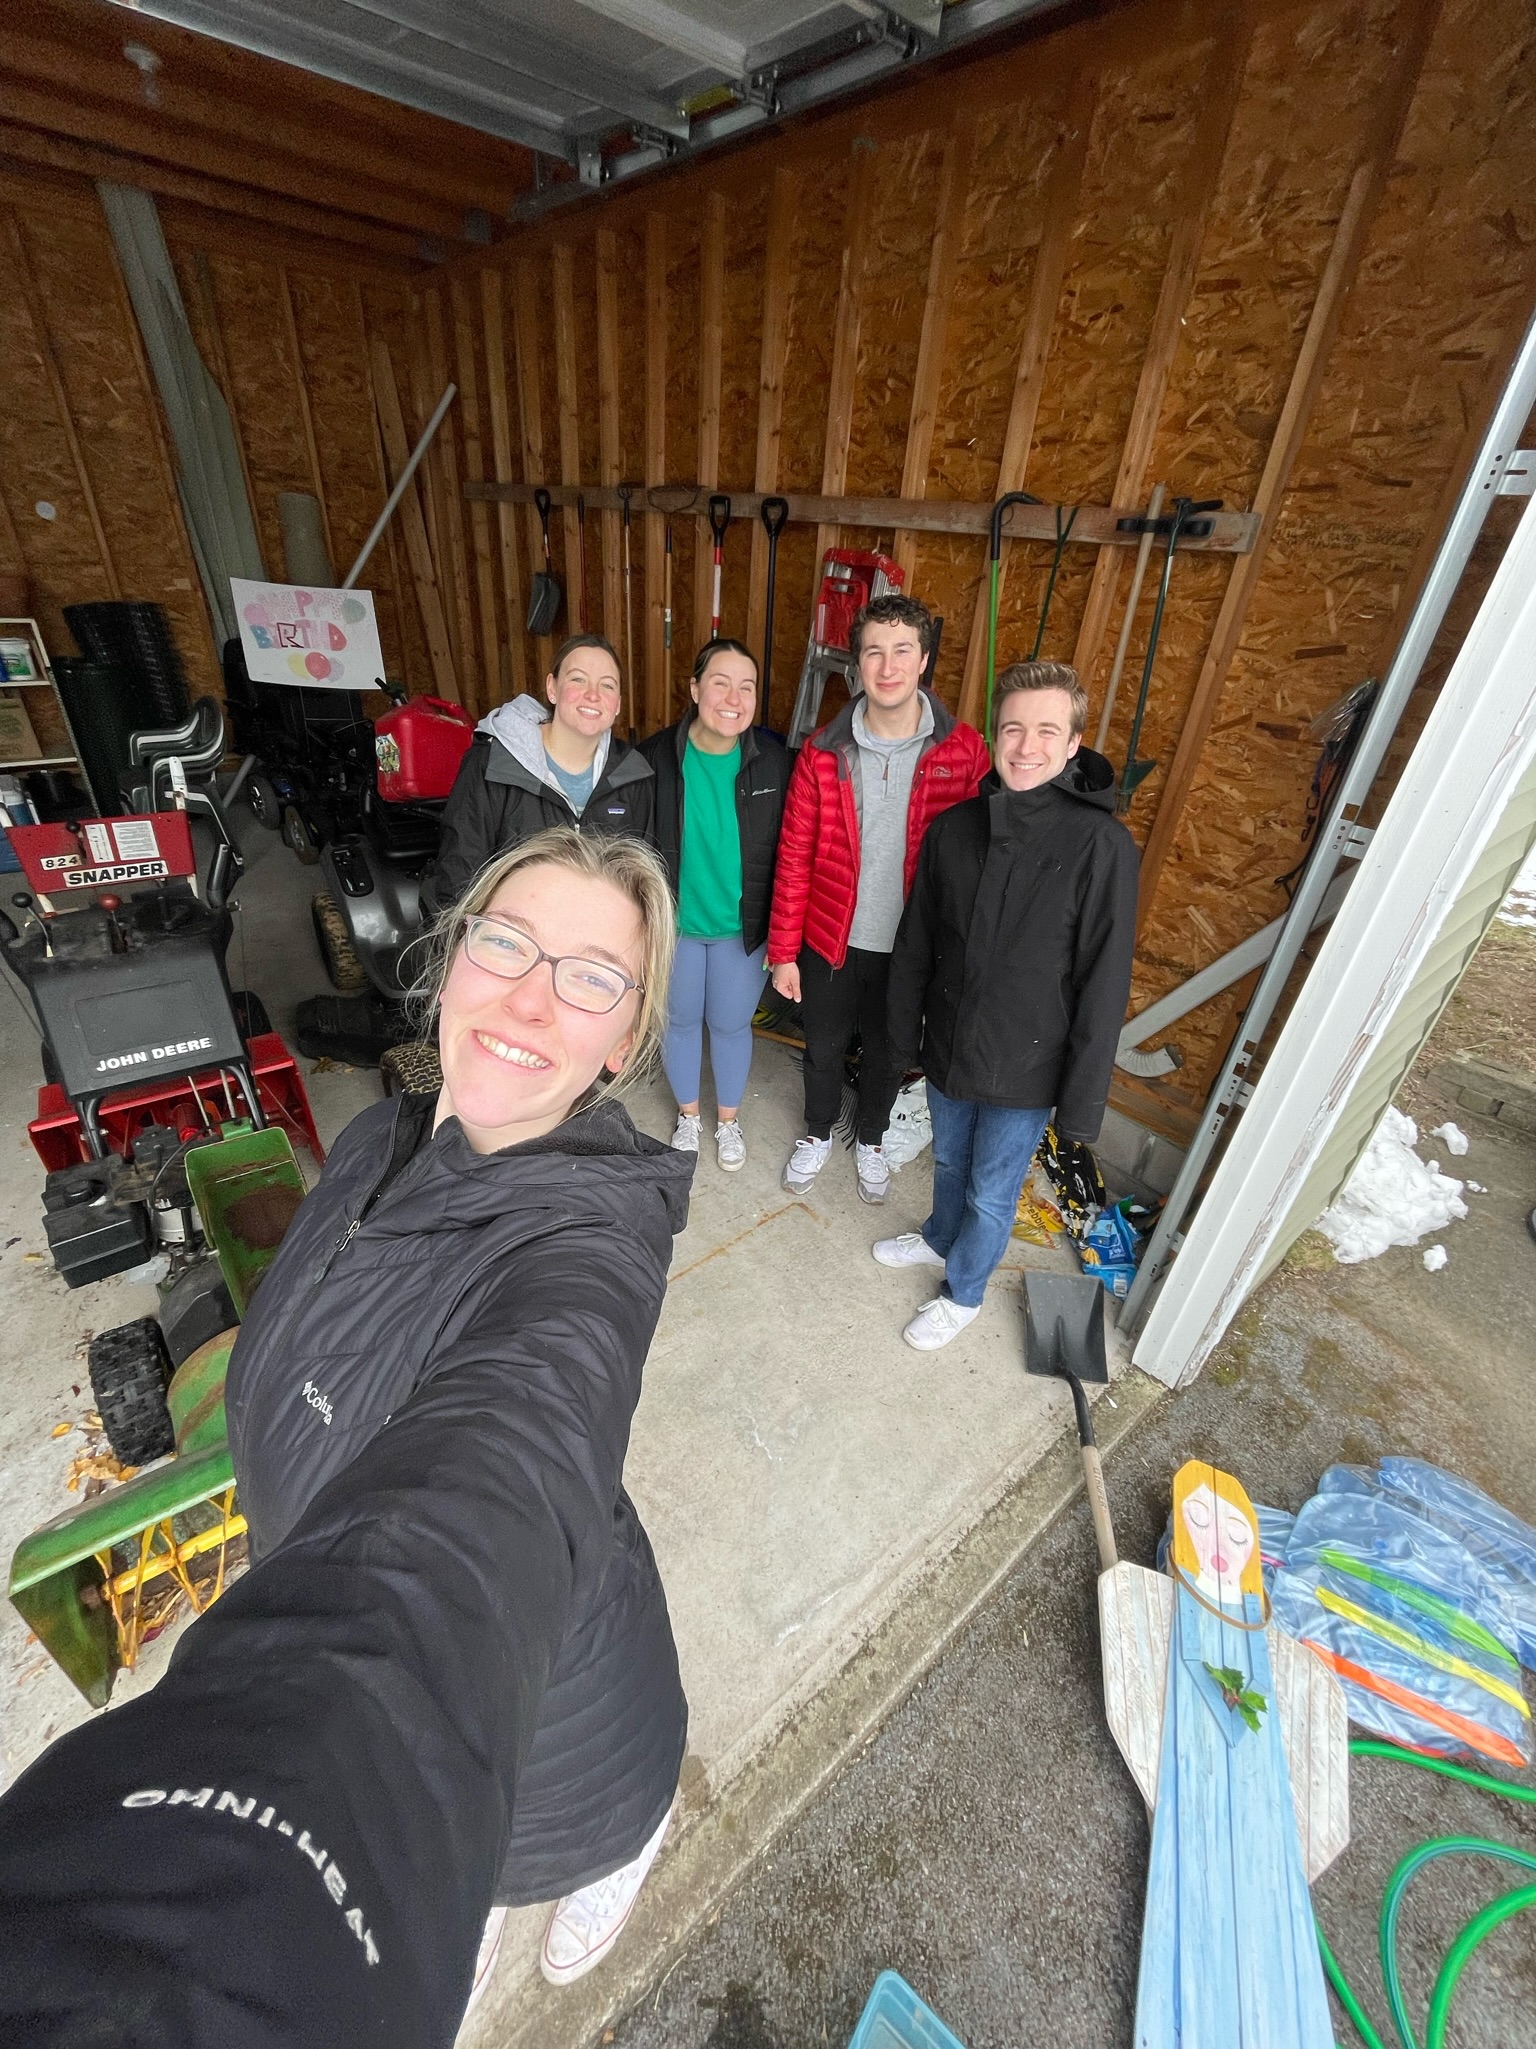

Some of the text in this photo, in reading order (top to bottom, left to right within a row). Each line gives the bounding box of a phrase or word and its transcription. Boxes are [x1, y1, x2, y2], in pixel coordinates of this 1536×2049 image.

[45, 856, 79, 869] 824
[68, 863, 163, 886] SNAPPER
[96, 1037, 213, 1072] JOHN DEERE
[1023, 1202, 1049, 1233] ebble
